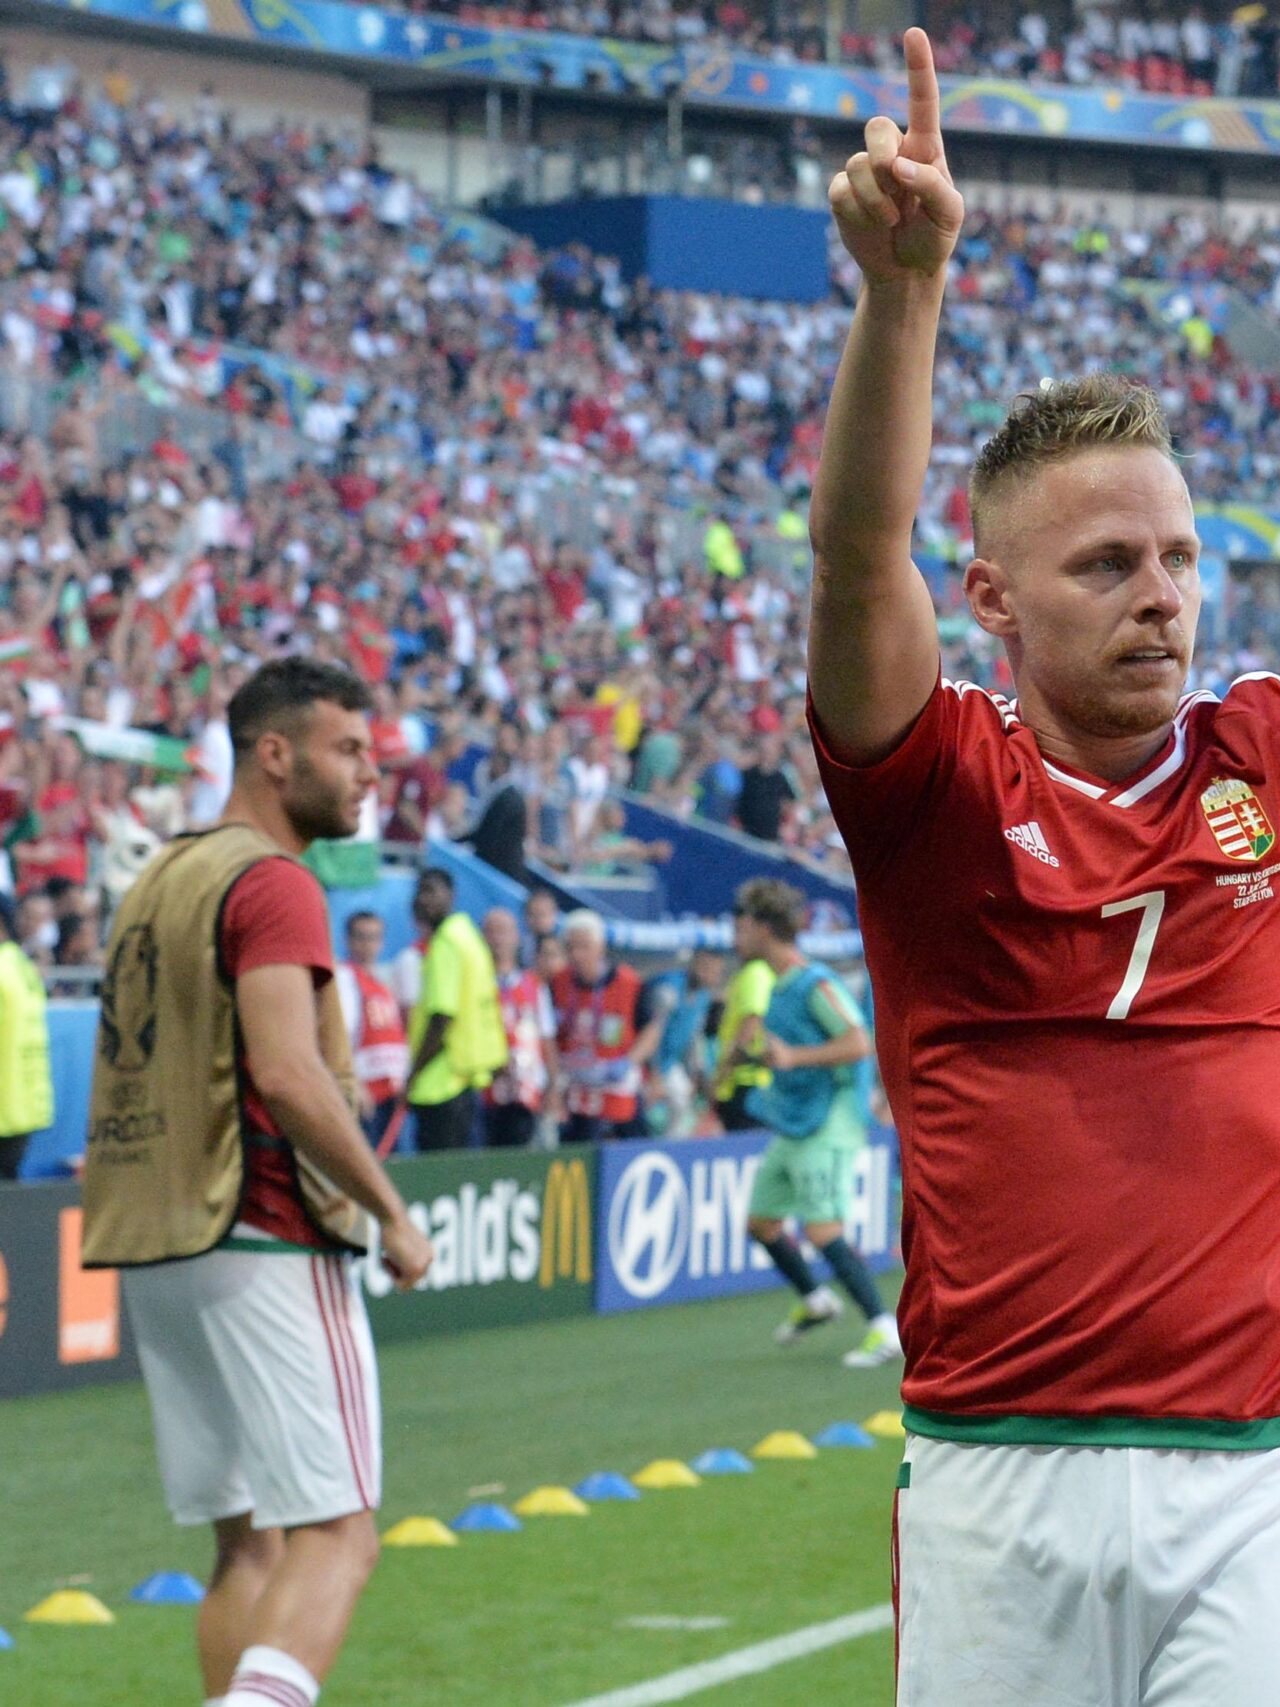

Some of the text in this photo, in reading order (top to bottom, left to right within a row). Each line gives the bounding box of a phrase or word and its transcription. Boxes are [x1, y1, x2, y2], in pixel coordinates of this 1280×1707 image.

[1004, 829, 1060, 868] adidas
[1216, 873, 1252, 887] HUNGARY
[1101, 890, 1165, 1020] 7
[690, 1147, 890, 1279] HYAI
